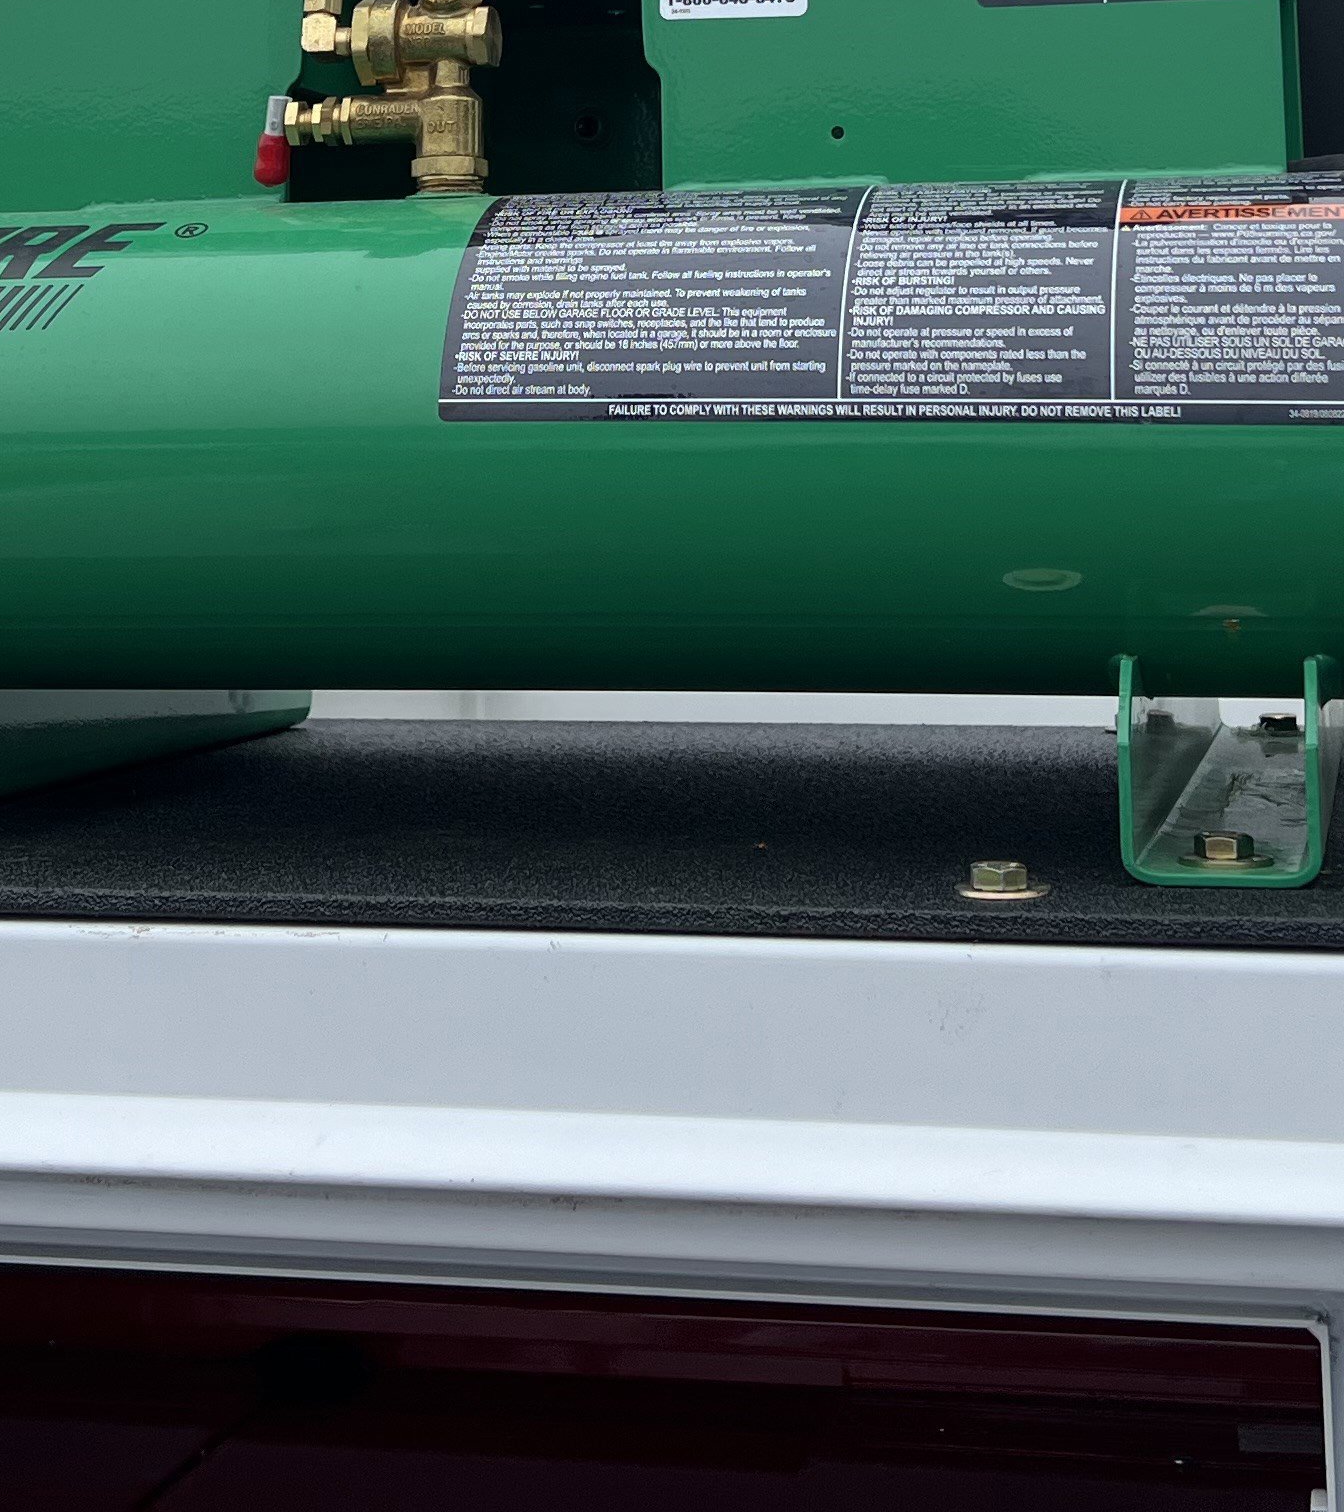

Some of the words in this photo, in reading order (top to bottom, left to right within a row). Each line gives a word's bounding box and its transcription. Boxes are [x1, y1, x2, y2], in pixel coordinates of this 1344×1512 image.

[404, 22, 445, 35] MODEL
[426, 121, 455, 133] OUT
[855, 277, 879, 285] RISK
[882, 277, 896, 285] OF
[480, 311, 500, 319] NOT
[502, 311, 521, 319] USE
[522, 310, 557, 318] BELOW
[558, 310, 599, 318] GARAGE
[600, 309, 634, 318] FLOOR
[635, 309, 650, 317] OR
[652, 308, 686, 317] GRADE
[741, 308, 787, 317] equipment
[853, 307, 878, 315] RISK
[880, 306, 894, 315] OF
[896, 306, 953, 315] DAMAGING
[955, 306, 1030, 314] COMPRESSOR
[1032, 306, 1055, 314] AND
[1057, 305, 1106, 314] CAUSING
[853, 317, 893, 326] INJURY!
[1150, 338, 1170, 347] PAS
[1172, 337, 1219, 347] UTILISER
[1221, 338, 1252, 347] SOUS
[1254, 337, 1270, 347] UN
[459, 352, 481, 361] RISK
[484, 352, 497, 360] OF
[500, 352, 538, 360] SEVERE
[1134, 349, 1150, 358] OU
[1224, 349, 1239, 358] DU
[1241, 349, 1281, 358] NIVEAU
[1283, 349, 1299, 358] DU
[470, 386, 484, 394] not
[486, 385, 510, 394] direct
[512, 385, 522, 394] air
[525, 385, 555, 394] stream
[557, 385, 566, 394] at
[568, 385, 591, 397] body.
[608, 405, 651, 416] FAILURE
[654, 405, 667, 415] TO
[670, 405, 712, 415] COMPLY
[713, 405, 739, 415] WITH
[741, 405, 775, 415] THESE
[777, 405, 833, 415] WARNINGS
[835, 405, 861, 415] WILL
[863, 405, 903, 416] RESULT
[906, 405, 917, 416] IN
[919, 405, 976, 417] PERSONAL
[1021, 406, 1036, 417] DO
[1038, 406, 1062, 417] NOT
[1064, 406, 1111, 417] REMOVE
[1114, 407, 1138, 417] THIS
[1141, 407, 1181, 418] LABEL!
